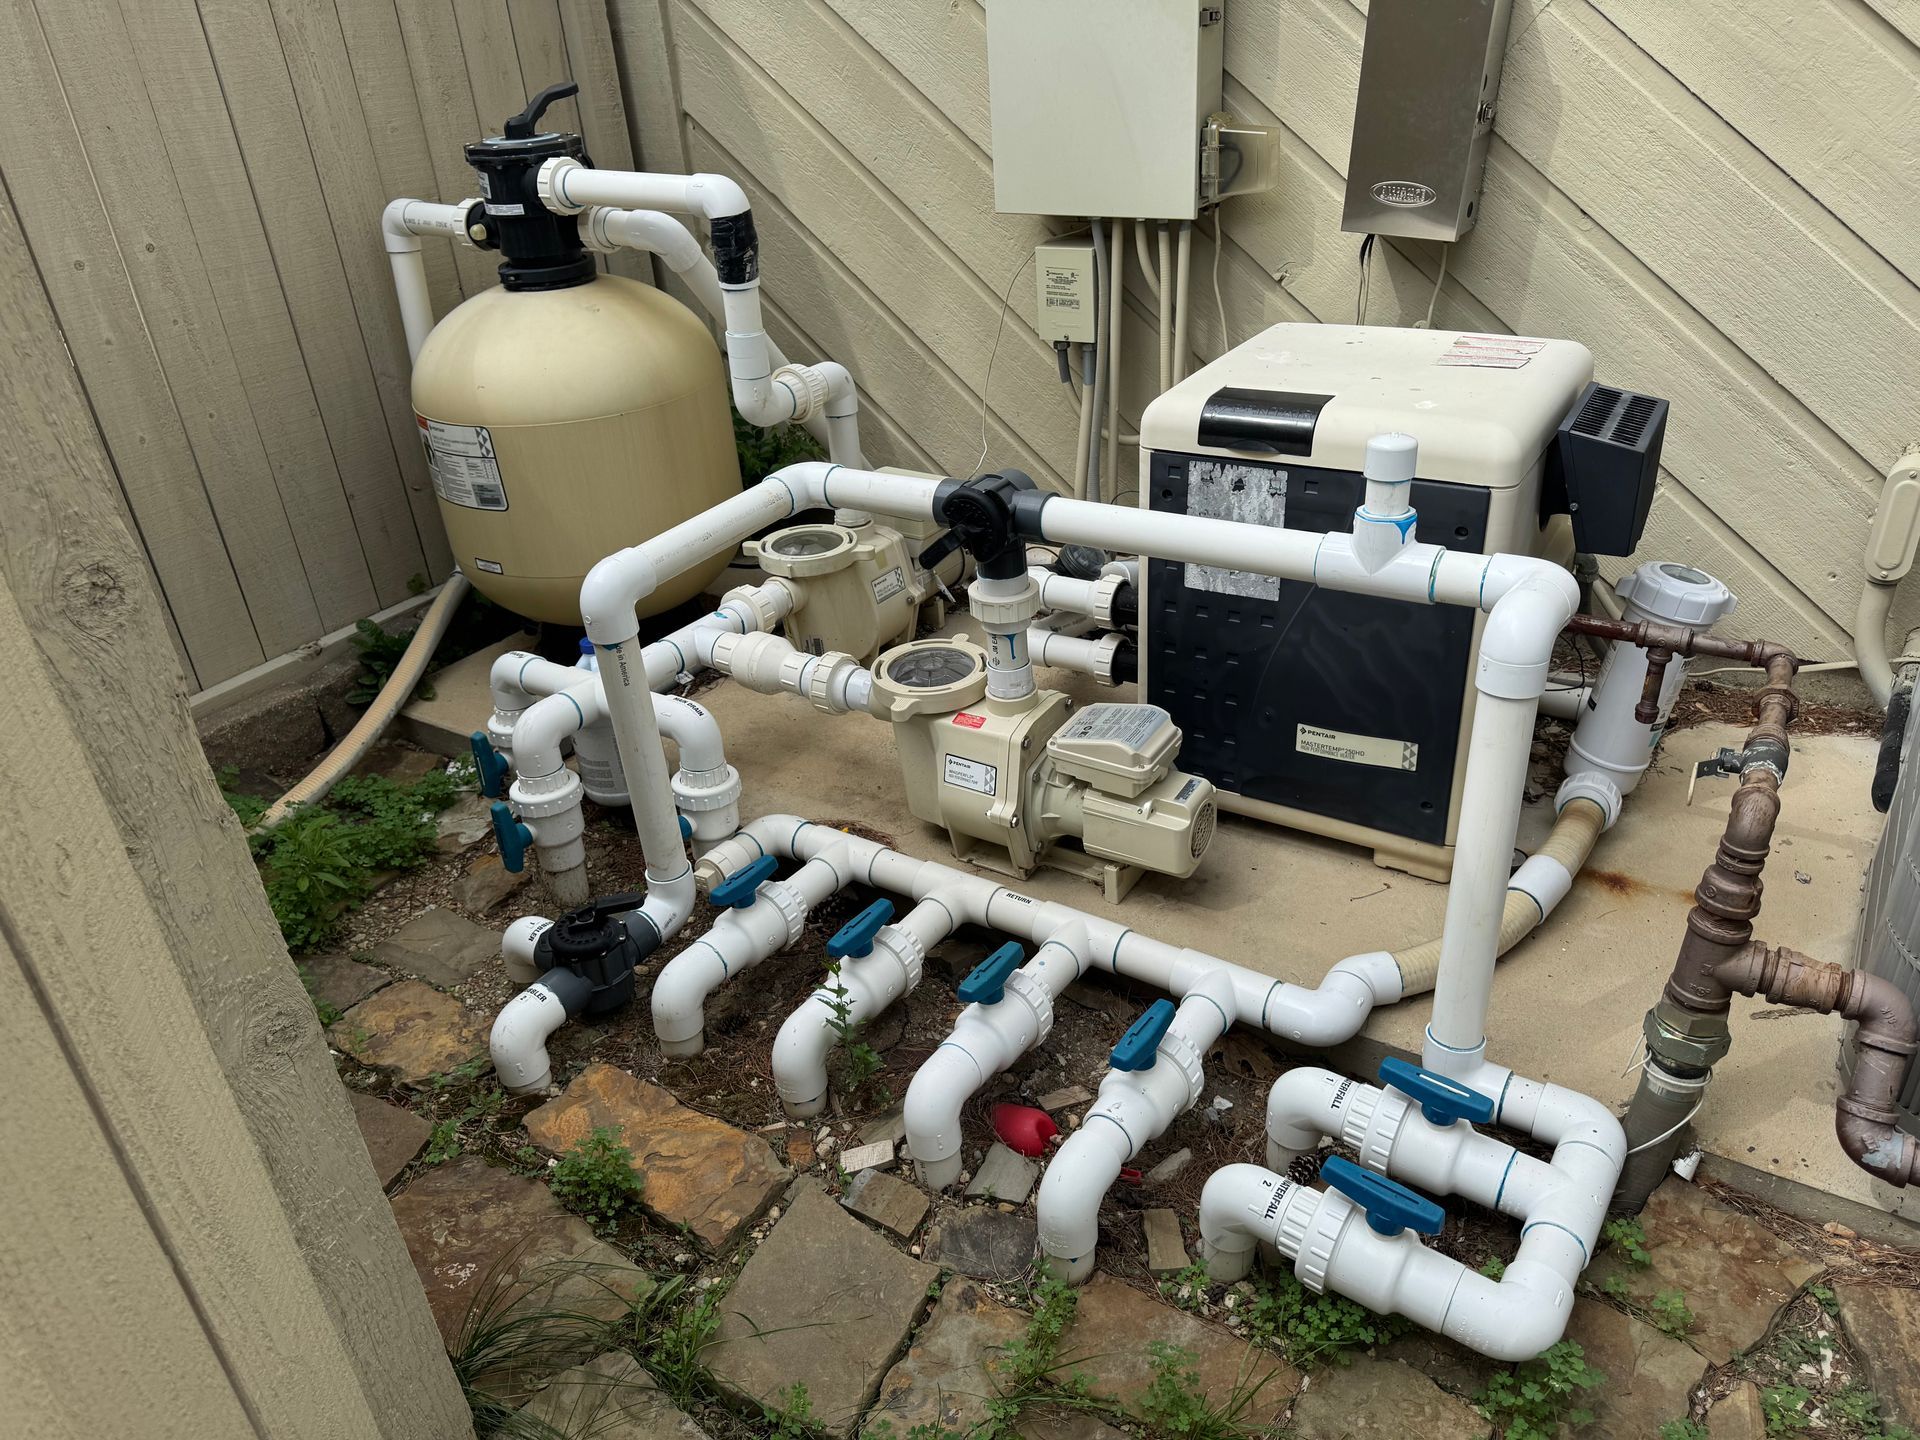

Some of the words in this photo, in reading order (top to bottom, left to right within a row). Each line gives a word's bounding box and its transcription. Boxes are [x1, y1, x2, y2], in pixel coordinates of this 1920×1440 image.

[619, 661, 631, 687] America
[687, 702, 704, 717] DRAIN
[1307, 729, 1336, 741] PENTAIR
[953, 760, 971, 769] PENTAIR
[1006, 892, 1032, 904] RETURN
[529, 921, 555, 942] UBBLER
[1330, 1078, 1353, 1109] TERFALL
